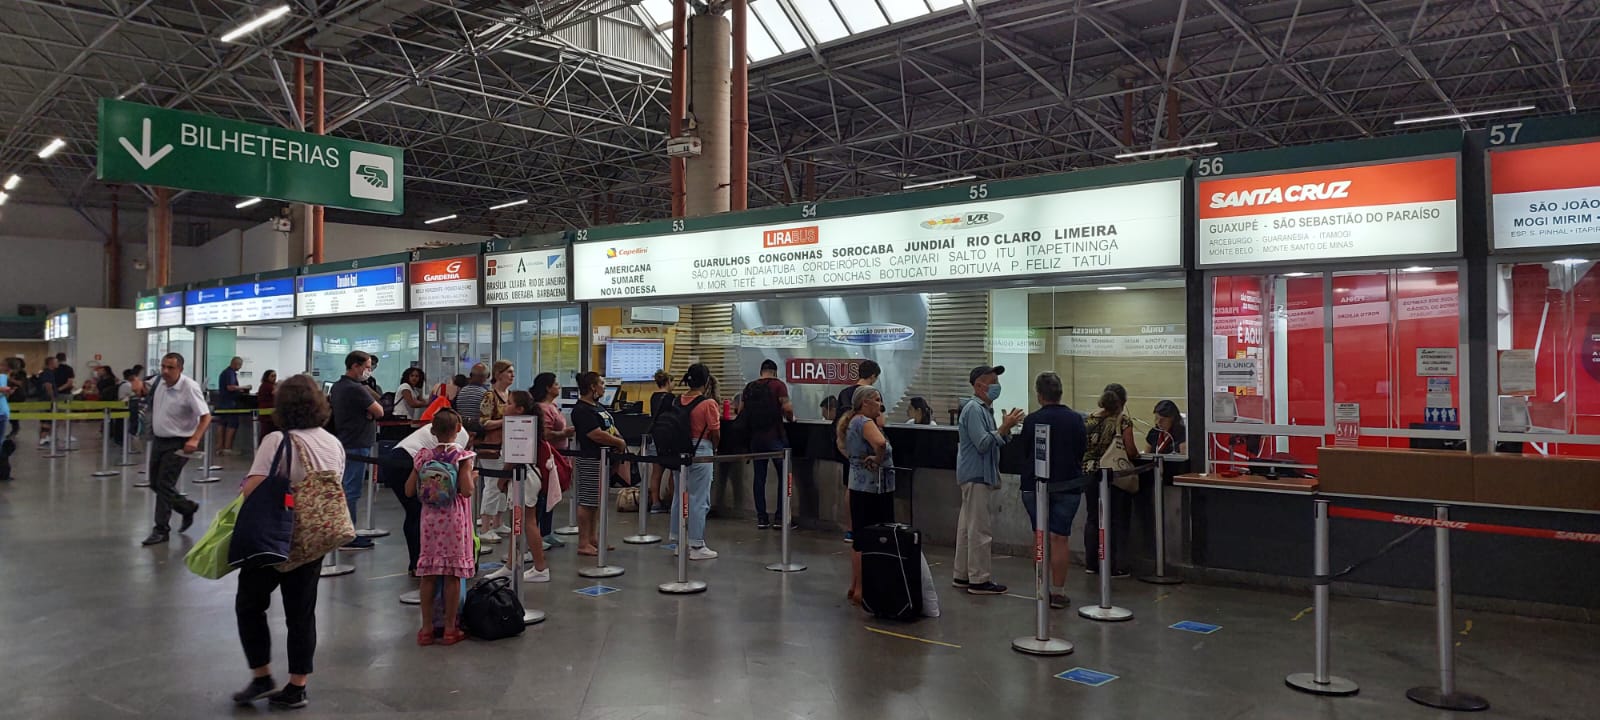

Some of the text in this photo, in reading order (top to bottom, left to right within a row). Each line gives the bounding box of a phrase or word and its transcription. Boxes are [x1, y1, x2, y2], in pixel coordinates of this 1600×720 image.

[1490, 123, 1523, 145] 57
[181, 123, 339, 168] BILHETERIAS
[1198, 157, 1224, 176] 56
[969, 184, 988, 199] 55
[1209, 180, 1353, 209] SANTA CRUZ
[802, 204, 817, 218] 54
[1529, 199, 1600, 213] SÃO JOÃO
[673, 220, 684, 232] 53
[1209, 206, 1441, 234] GUAXUPÉ SÃO SEBASTIÃO DO PARAÍSO
[1514, 214, 1592, 228] MOGI MIRIM
[577, 230, 588, 241] 52
[1539, 228, 1568, 236] PINHAL
[487, 241, 495, 252] 51
[693, 224, 1118, 269] GUARULHOS CONGONHAS SOROCABA JUNDIAÍ RIO CLARO LIMEIRA
[1317, 242, 1328, 250] DE
[710, 267, 738, 279] PAULO
[744, 263, 796, 276] INDAIATUBA
[802, 257, 881, 272] CORDEIRÓPOLIS
[889, 253, 939, 267] CAPIVARI
[948, 249, 987, 262] SALTO
[996, 247, 1016, 259] ITU
[1026, 239, 1119, 257] ITAPETININGA
[604, 263, 652, 275] AMERICANA
[707, 279, 727, 289] MOR
[772, 274, 816, 287] PAULISTA
[822, 270, 872, 283] CONCHAS
[879, 266, 938, 280] BOTUCATU
[949, 261, 1001, 275] BOITUVA
[1026, 257, 1061, 271] FELIZ
[1072, 251, 1112, 268] TATUÍ
[600, 285, 657, 296] NOVA ODESSA
[791, 362, 860, 380] LIRABUS
[1392, 514, 1469, 530] SANTA CRUZ
